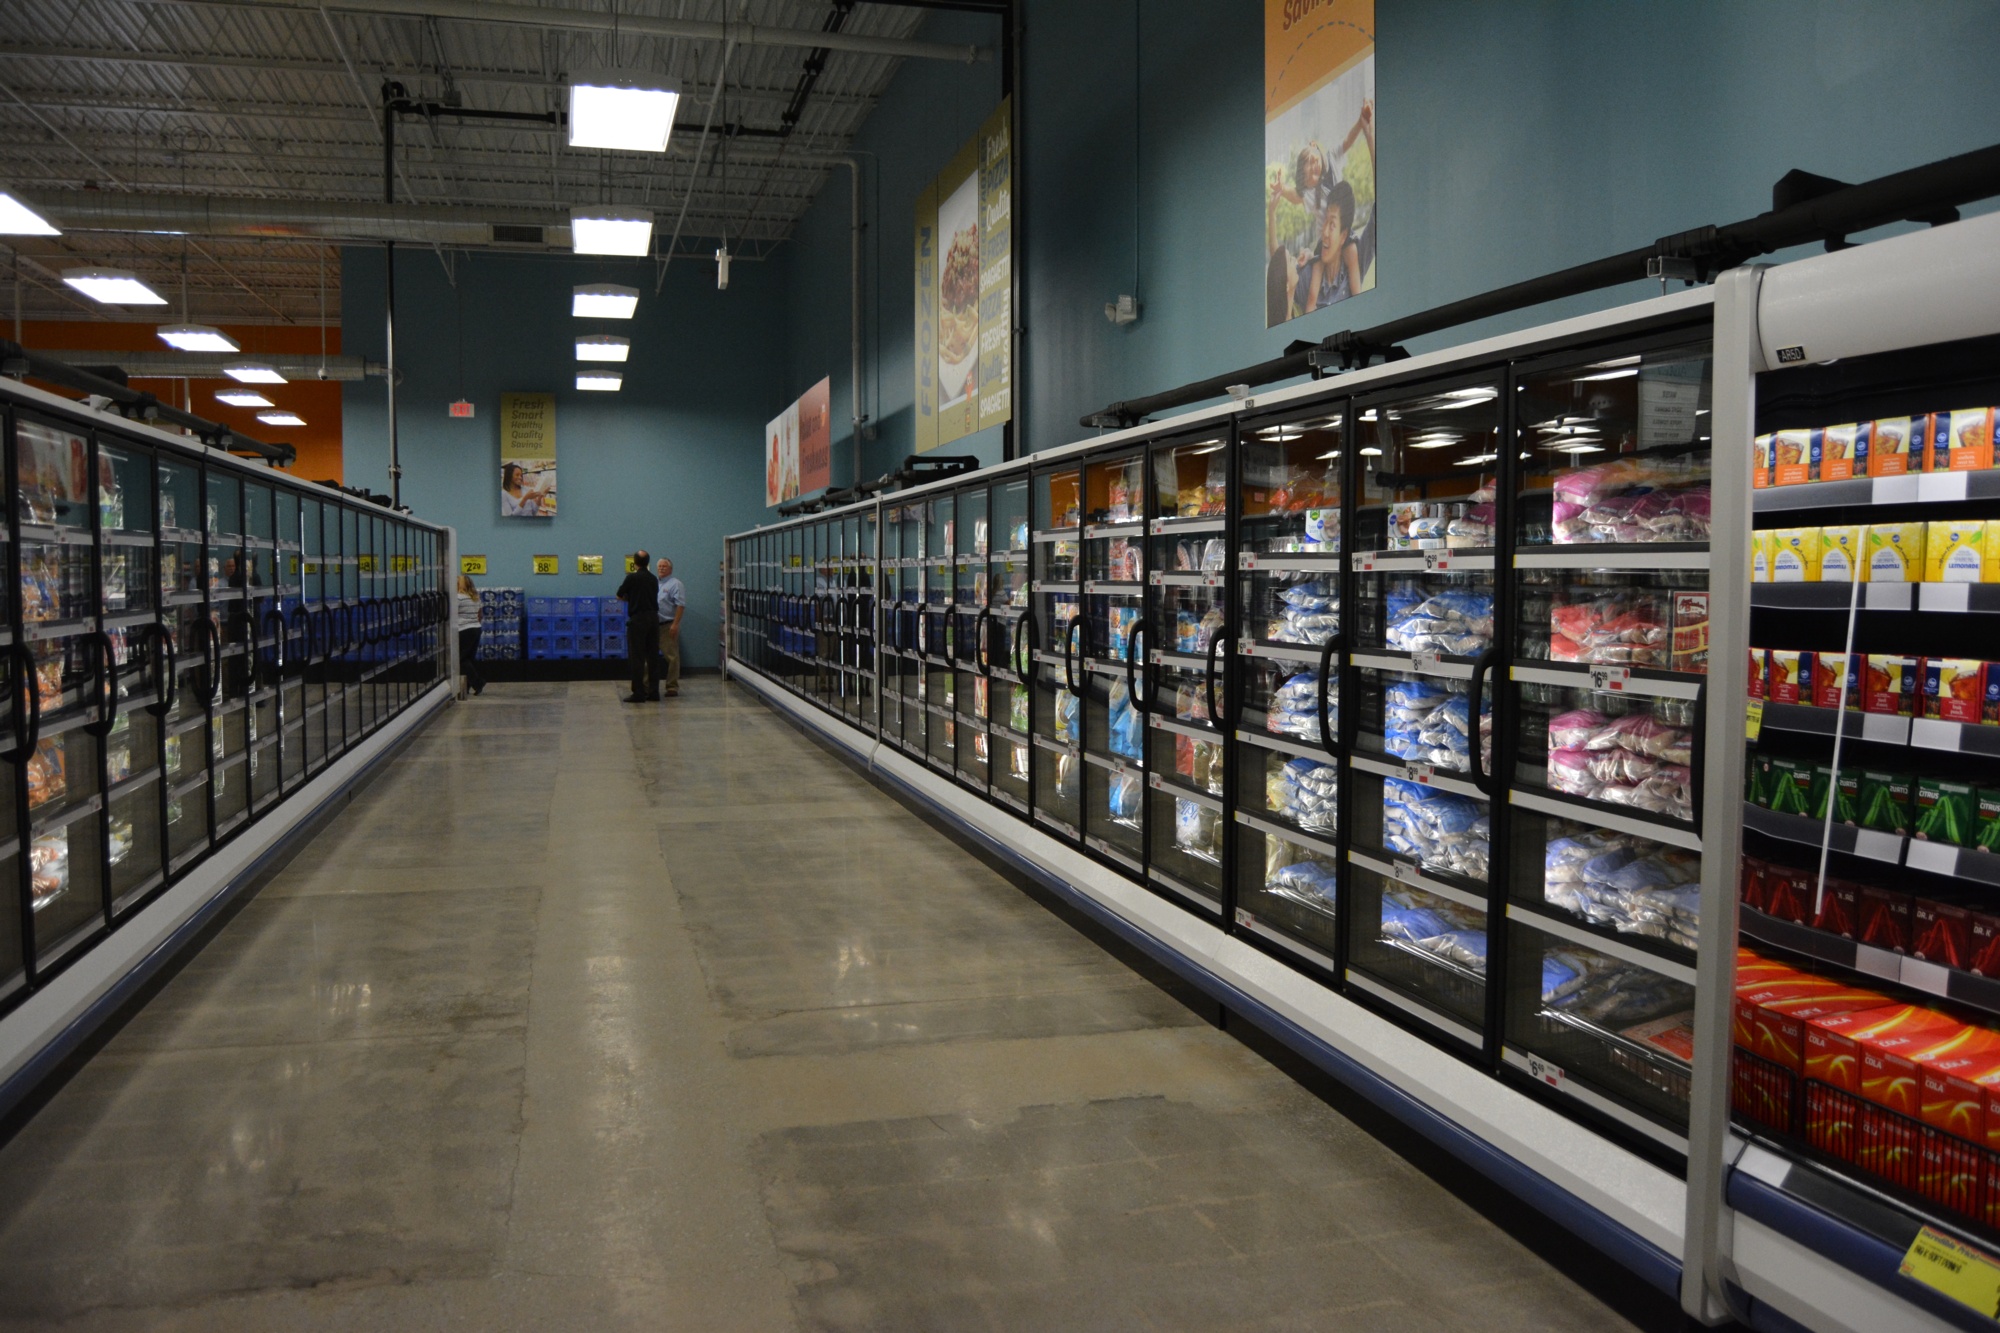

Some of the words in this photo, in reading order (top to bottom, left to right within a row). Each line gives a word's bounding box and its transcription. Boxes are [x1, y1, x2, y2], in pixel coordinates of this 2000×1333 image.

[987, 116, 1008, 166] Fresh
[987, 153, 1008, 195] PIZZA
[987, 190, 1010, 232] Quality
[981, 255, 1010, 293] SPAGHETTI
[921, 227, 932, 416] FROZEN
[981, 324, 1001, 355] FRESH
[1001, 287, 1010, 384] Healthy
[454, 403, 471, 416] EXIT
[512, 399, 544, 410] Fresh
[981, 388, 1010, 418] SPAGHETTI
[512, 410, 544, 420] Smart
[511, 421, 543, 431] Healthy
[512, 431, 544, 441] Quality
[511, 441, 543, 450] Savings
[1674, 628, 1700, 652] RIB
[1919, 790, 1940, 800] CITRUS
[1917, 910, 1928, 920] DR.
[1973, 926, 1985, 936] DR.
[1986, 929, 1992, 937] K
[1809, 1035, 1825, 1048] COLA
[1865, 1056, 1883, 1070] COLA
[1925, 1079, 1944, 1093] COLA
